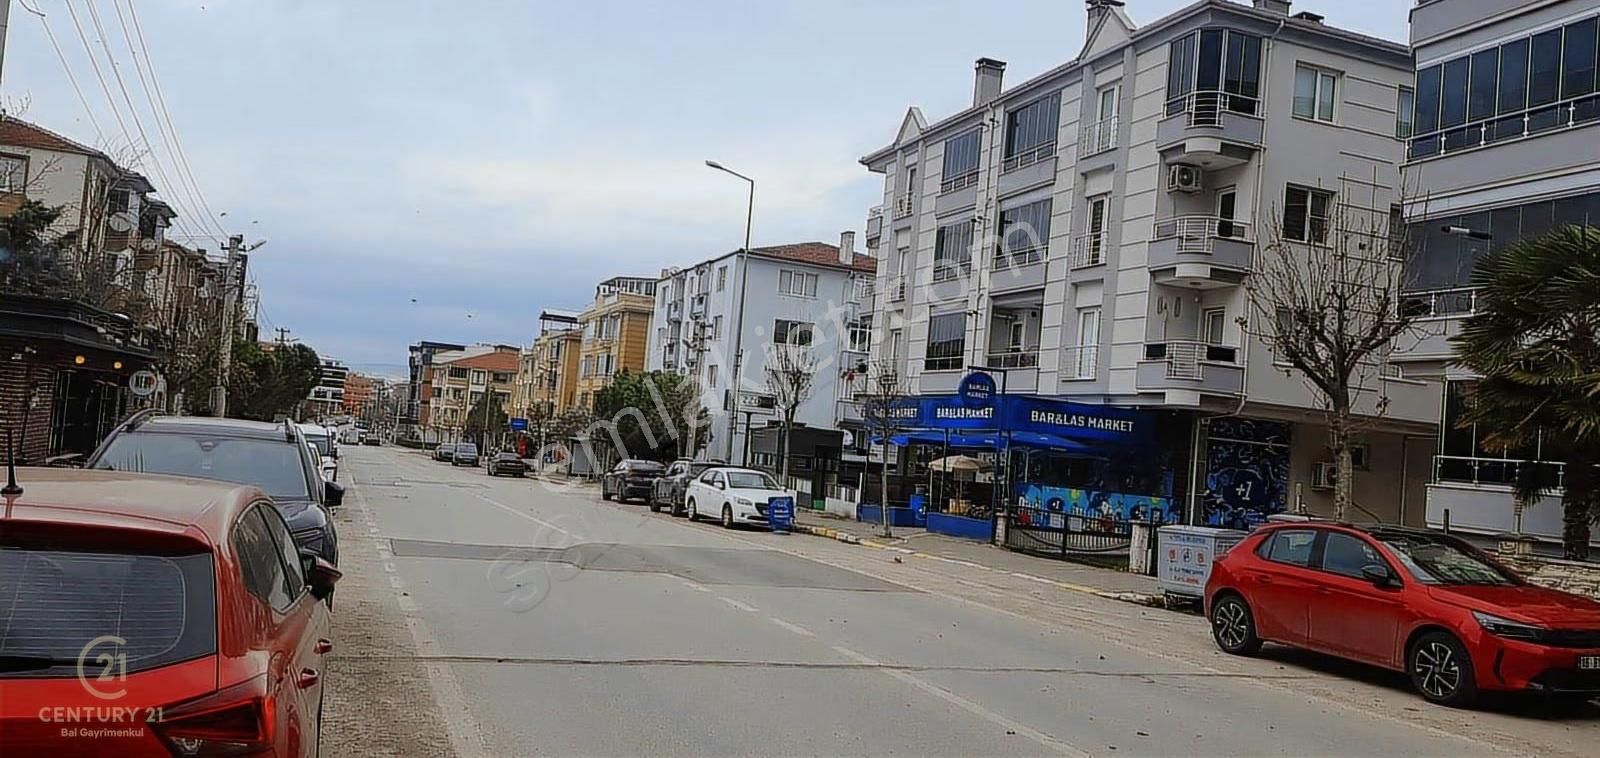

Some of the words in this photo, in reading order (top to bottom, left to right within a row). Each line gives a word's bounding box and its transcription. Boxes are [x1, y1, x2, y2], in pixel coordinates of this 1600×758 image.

[966, 407, 993, 418] MARKET
[1031, 410, 1085, 427] BAR&LAS
[1087, 416, 1134, 432] MARKET
[1235, 481, 1252, 501] +1
